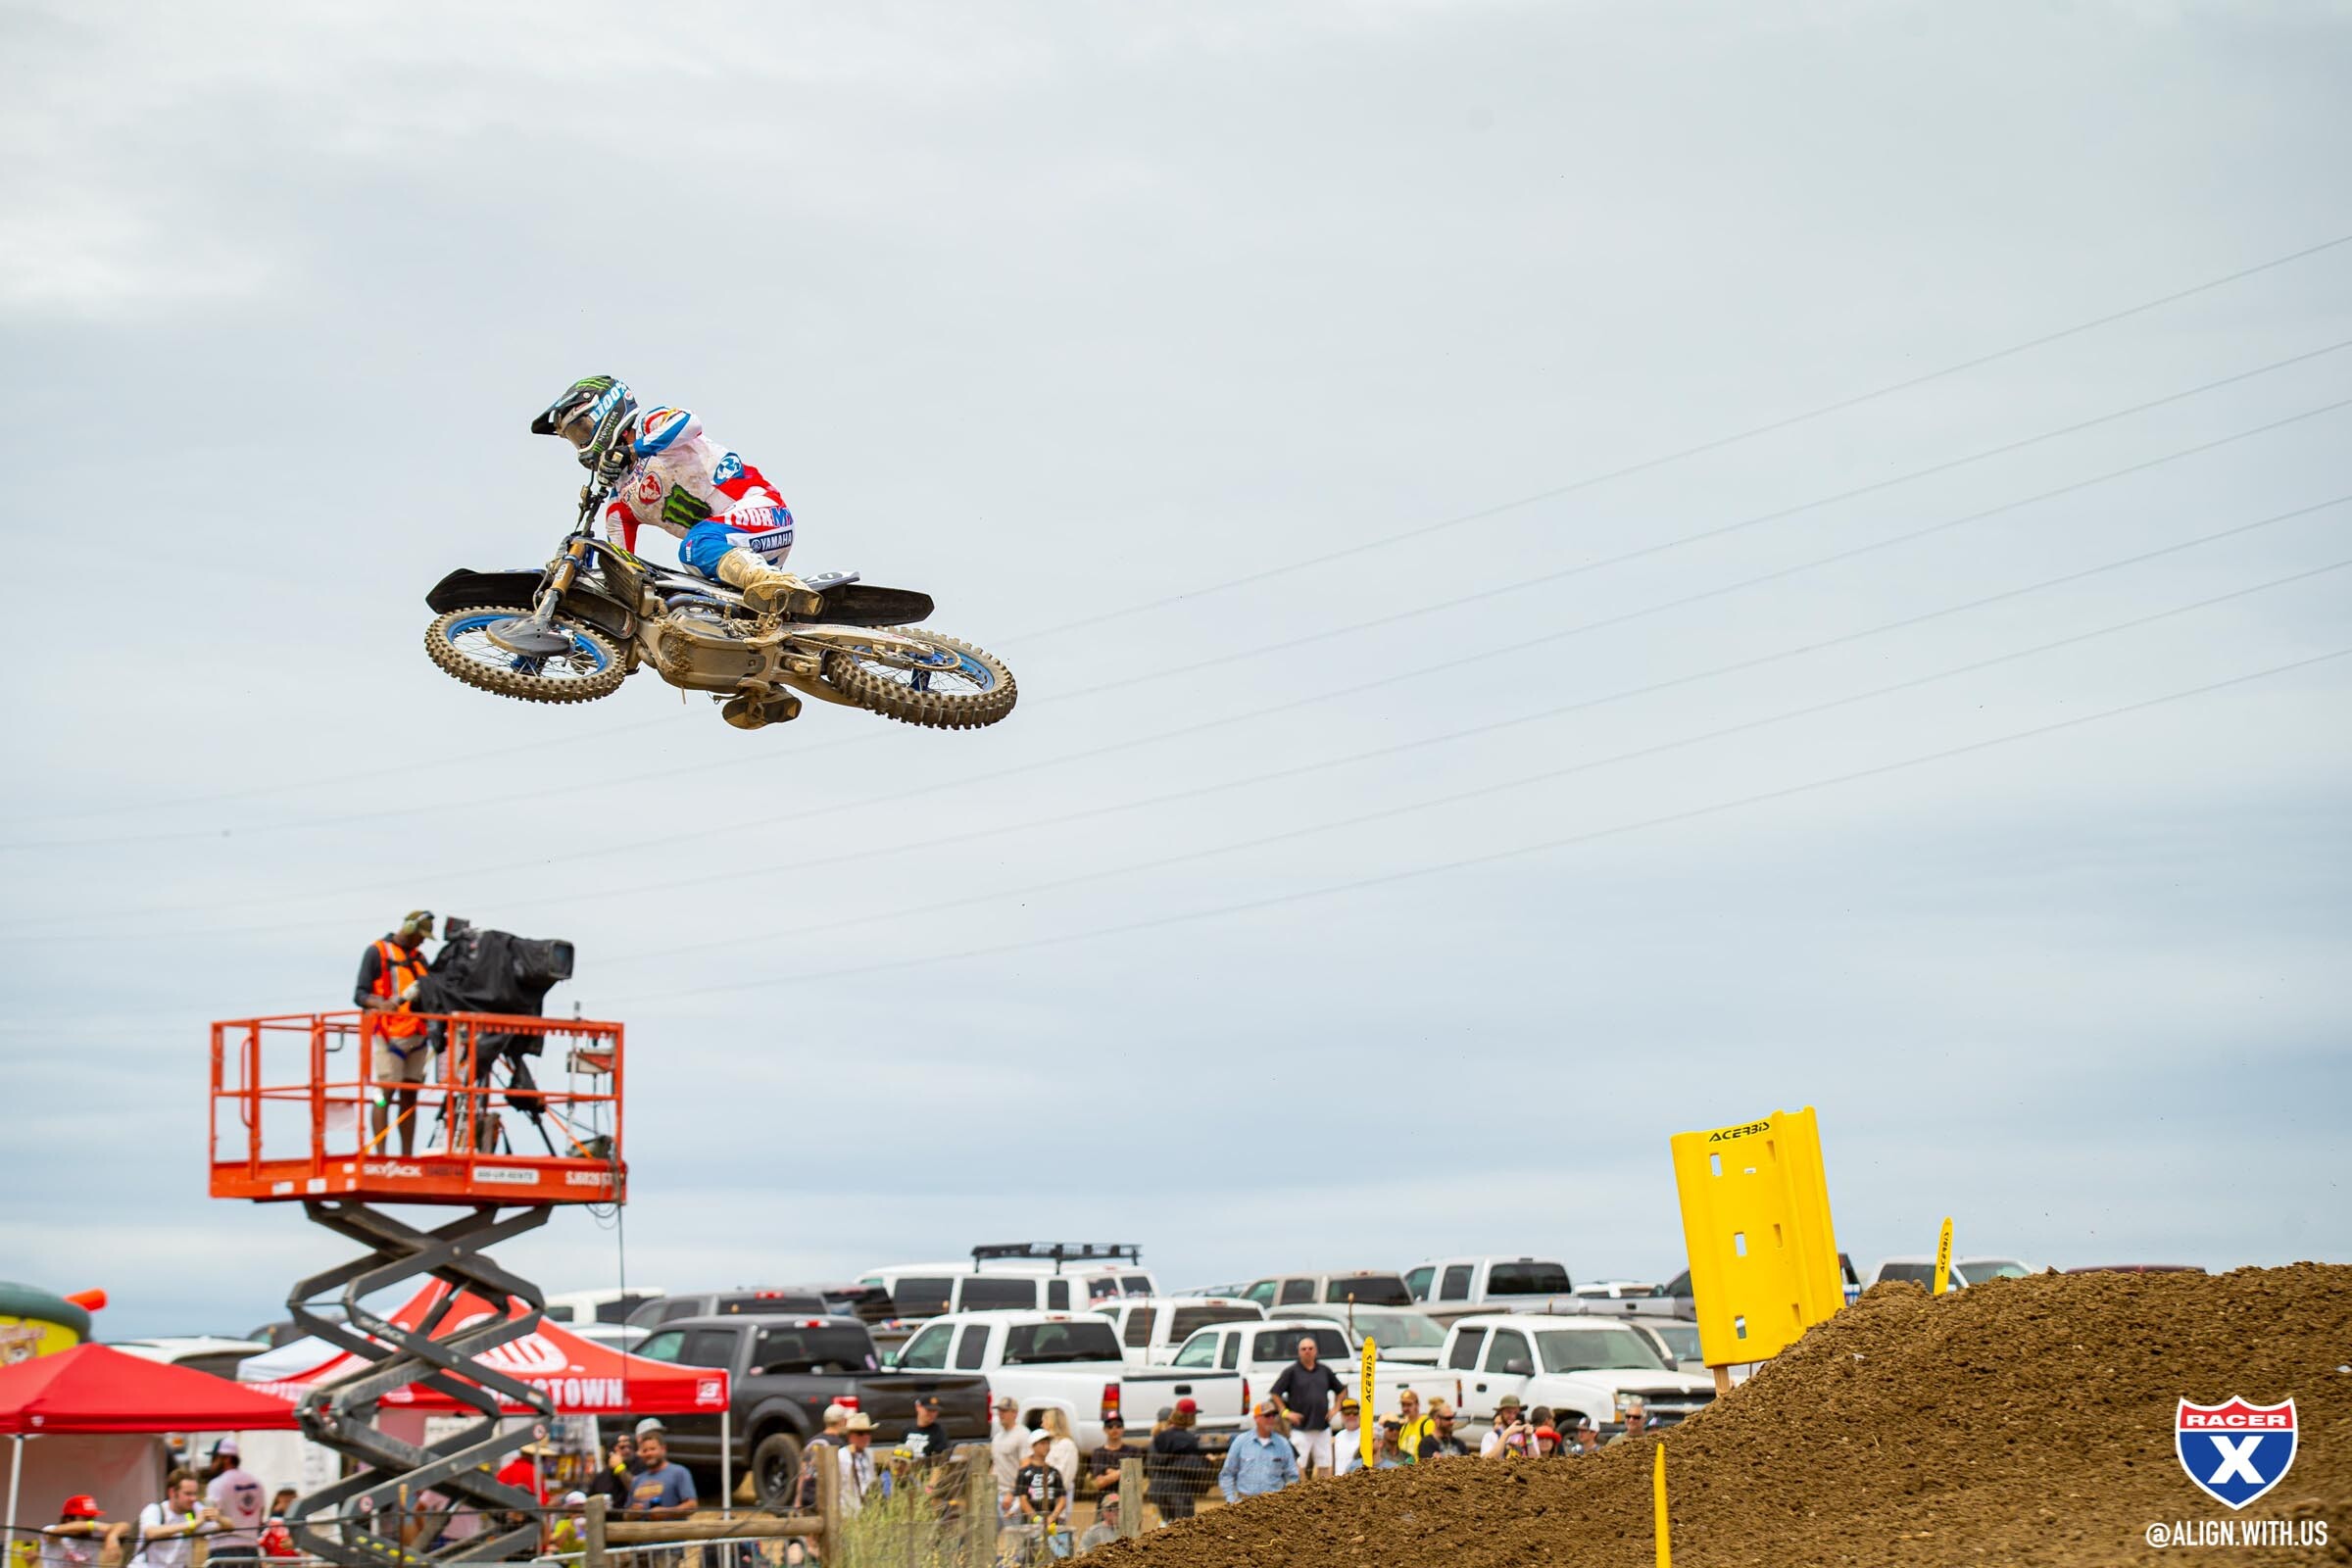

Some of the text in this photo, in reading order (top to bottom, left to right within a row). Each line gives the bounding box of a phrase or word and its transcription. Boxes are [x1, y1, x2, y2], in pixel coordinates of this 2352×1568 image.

[598, 411, 618, 441] MONSTER
[760, 532, 792, 551] YAMAHA
[1709, 1121, 1770, 1143] ACERBIS
[1940, 1232, 1949, 1274] ACERBIS
